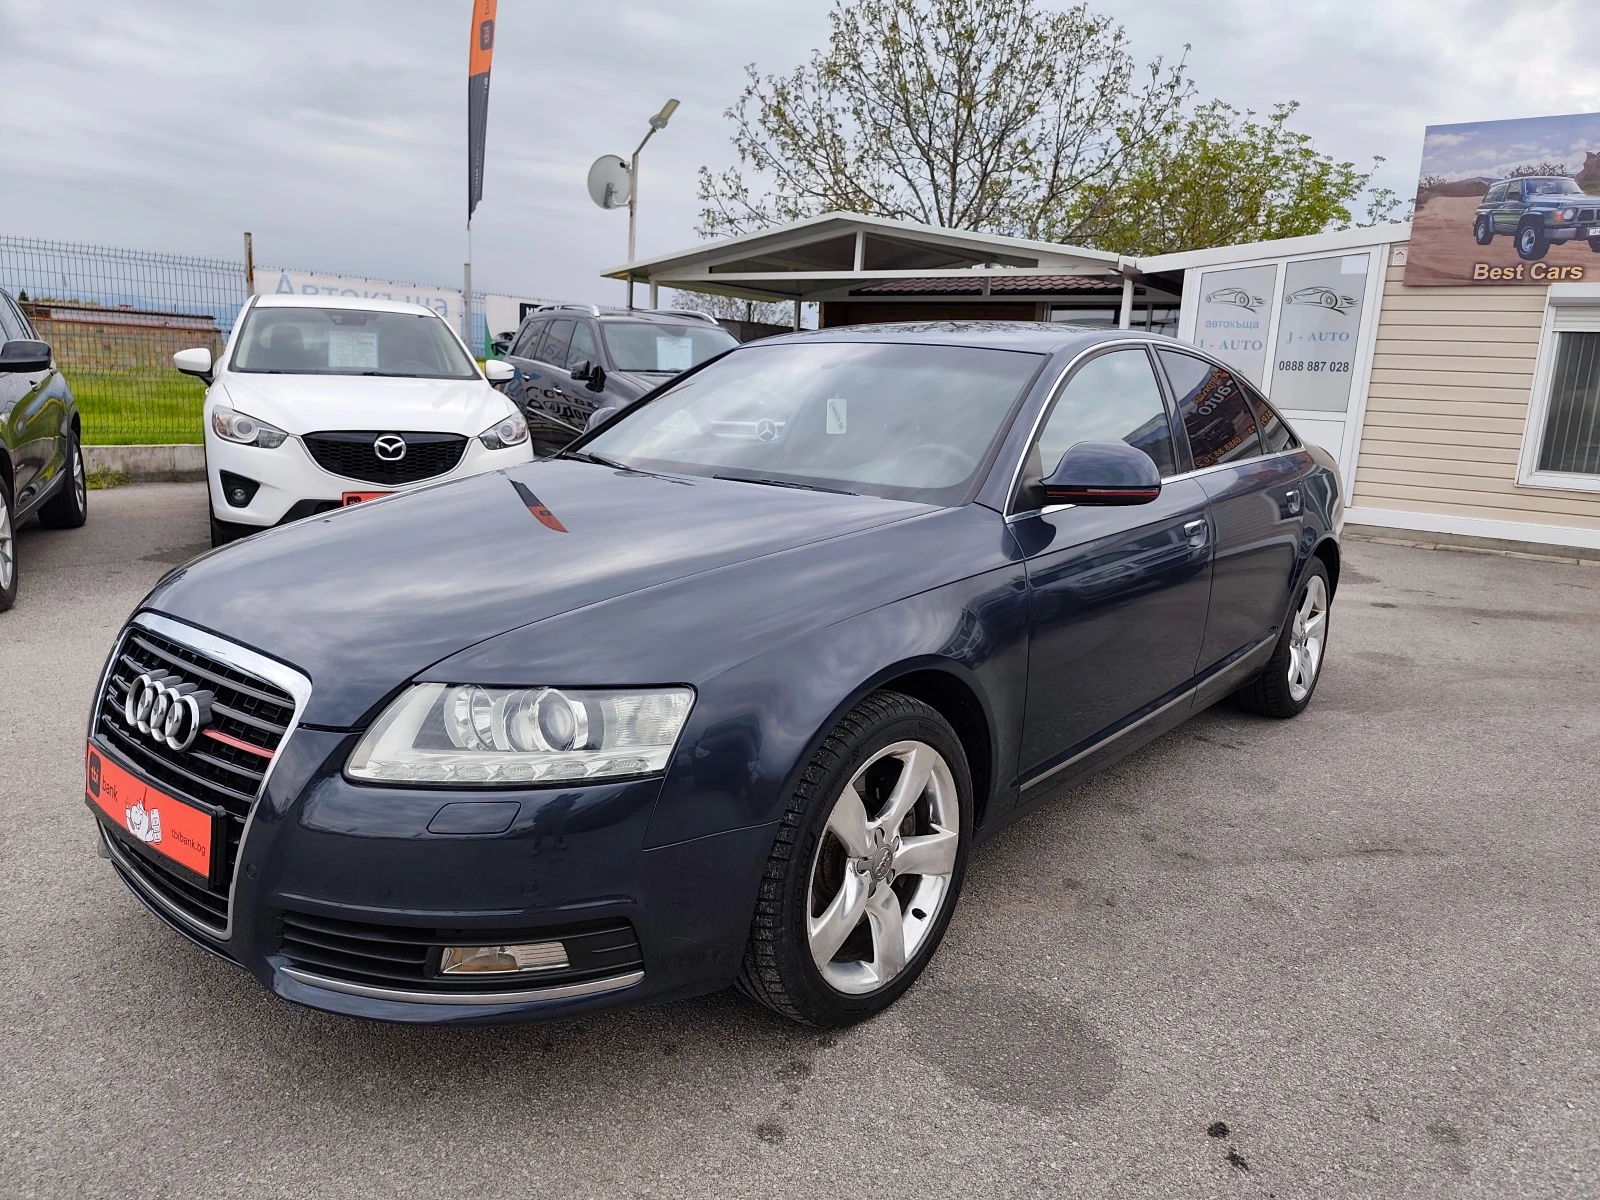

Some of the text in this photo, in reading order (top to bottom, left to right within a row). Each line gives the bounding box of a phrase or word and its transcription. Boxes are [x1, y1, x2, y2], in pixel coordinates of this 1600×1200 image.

[1473, 262, 1584, 280] Best Cars
[1205, 319, 1259, 331] автокъща
[1286, 332, 1293, 344] J
[1308, 331, 1350, 341] AUTO
[1219, 340, 1263, 350] AUTO
[1279, 361, 1350, 373] 0888 887 028
[91, 766, 118, 801] tbi bank
[171, 828, 206, 857] tbibank.bg
